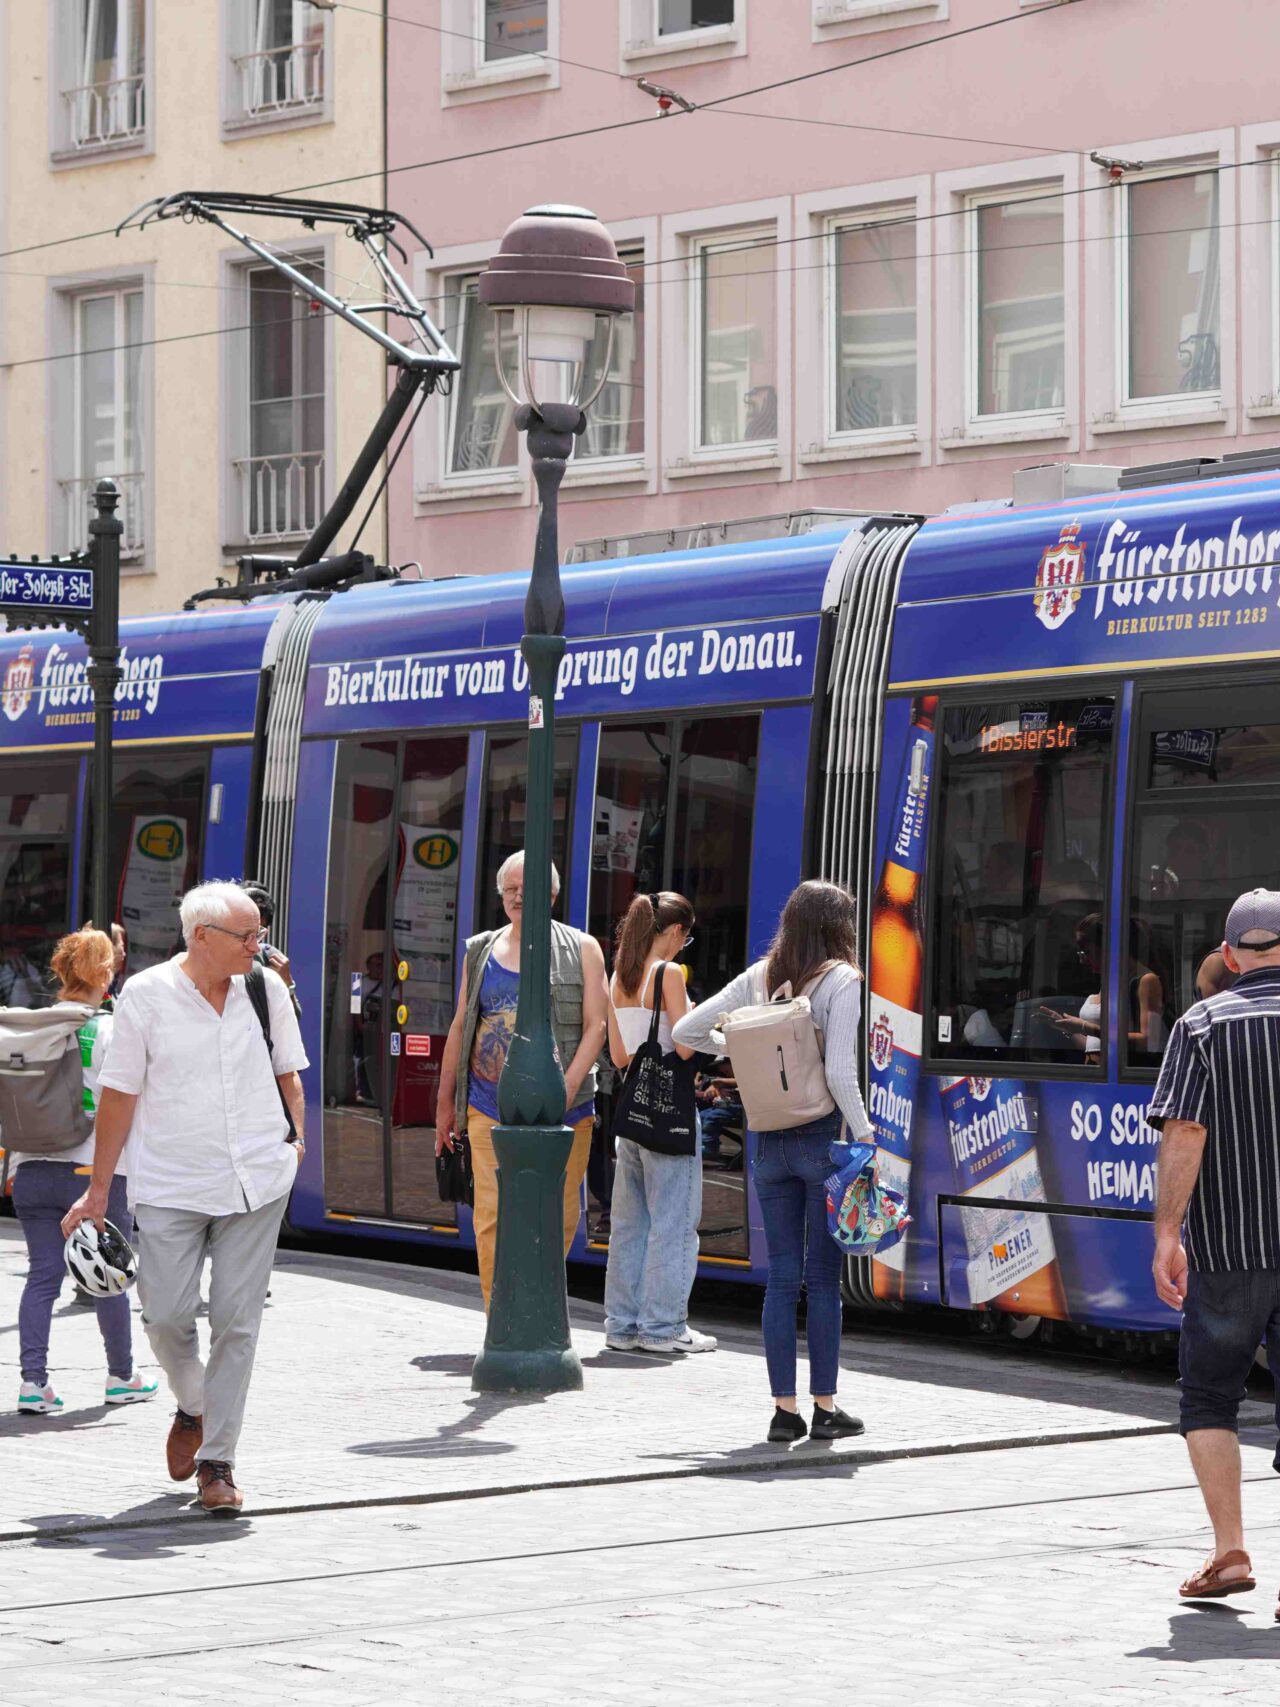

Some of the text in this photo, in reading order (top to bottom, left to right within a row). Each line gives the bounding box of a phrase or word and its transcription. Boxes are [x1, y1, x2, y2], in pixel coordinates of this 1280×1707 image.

[1106, 607, 1267, 636] BIERKULTUR SEIT 1283
[38, 643, 163, 715] fürstberg
[324, 629, 803, 707] Bierkultur vom Uprung der Donau.
[869, 1080, 912, 1141] enberg
[1071, 1100, 1163, 1146] SO SCH
[988, 1228, 1033, 1271] PENER
